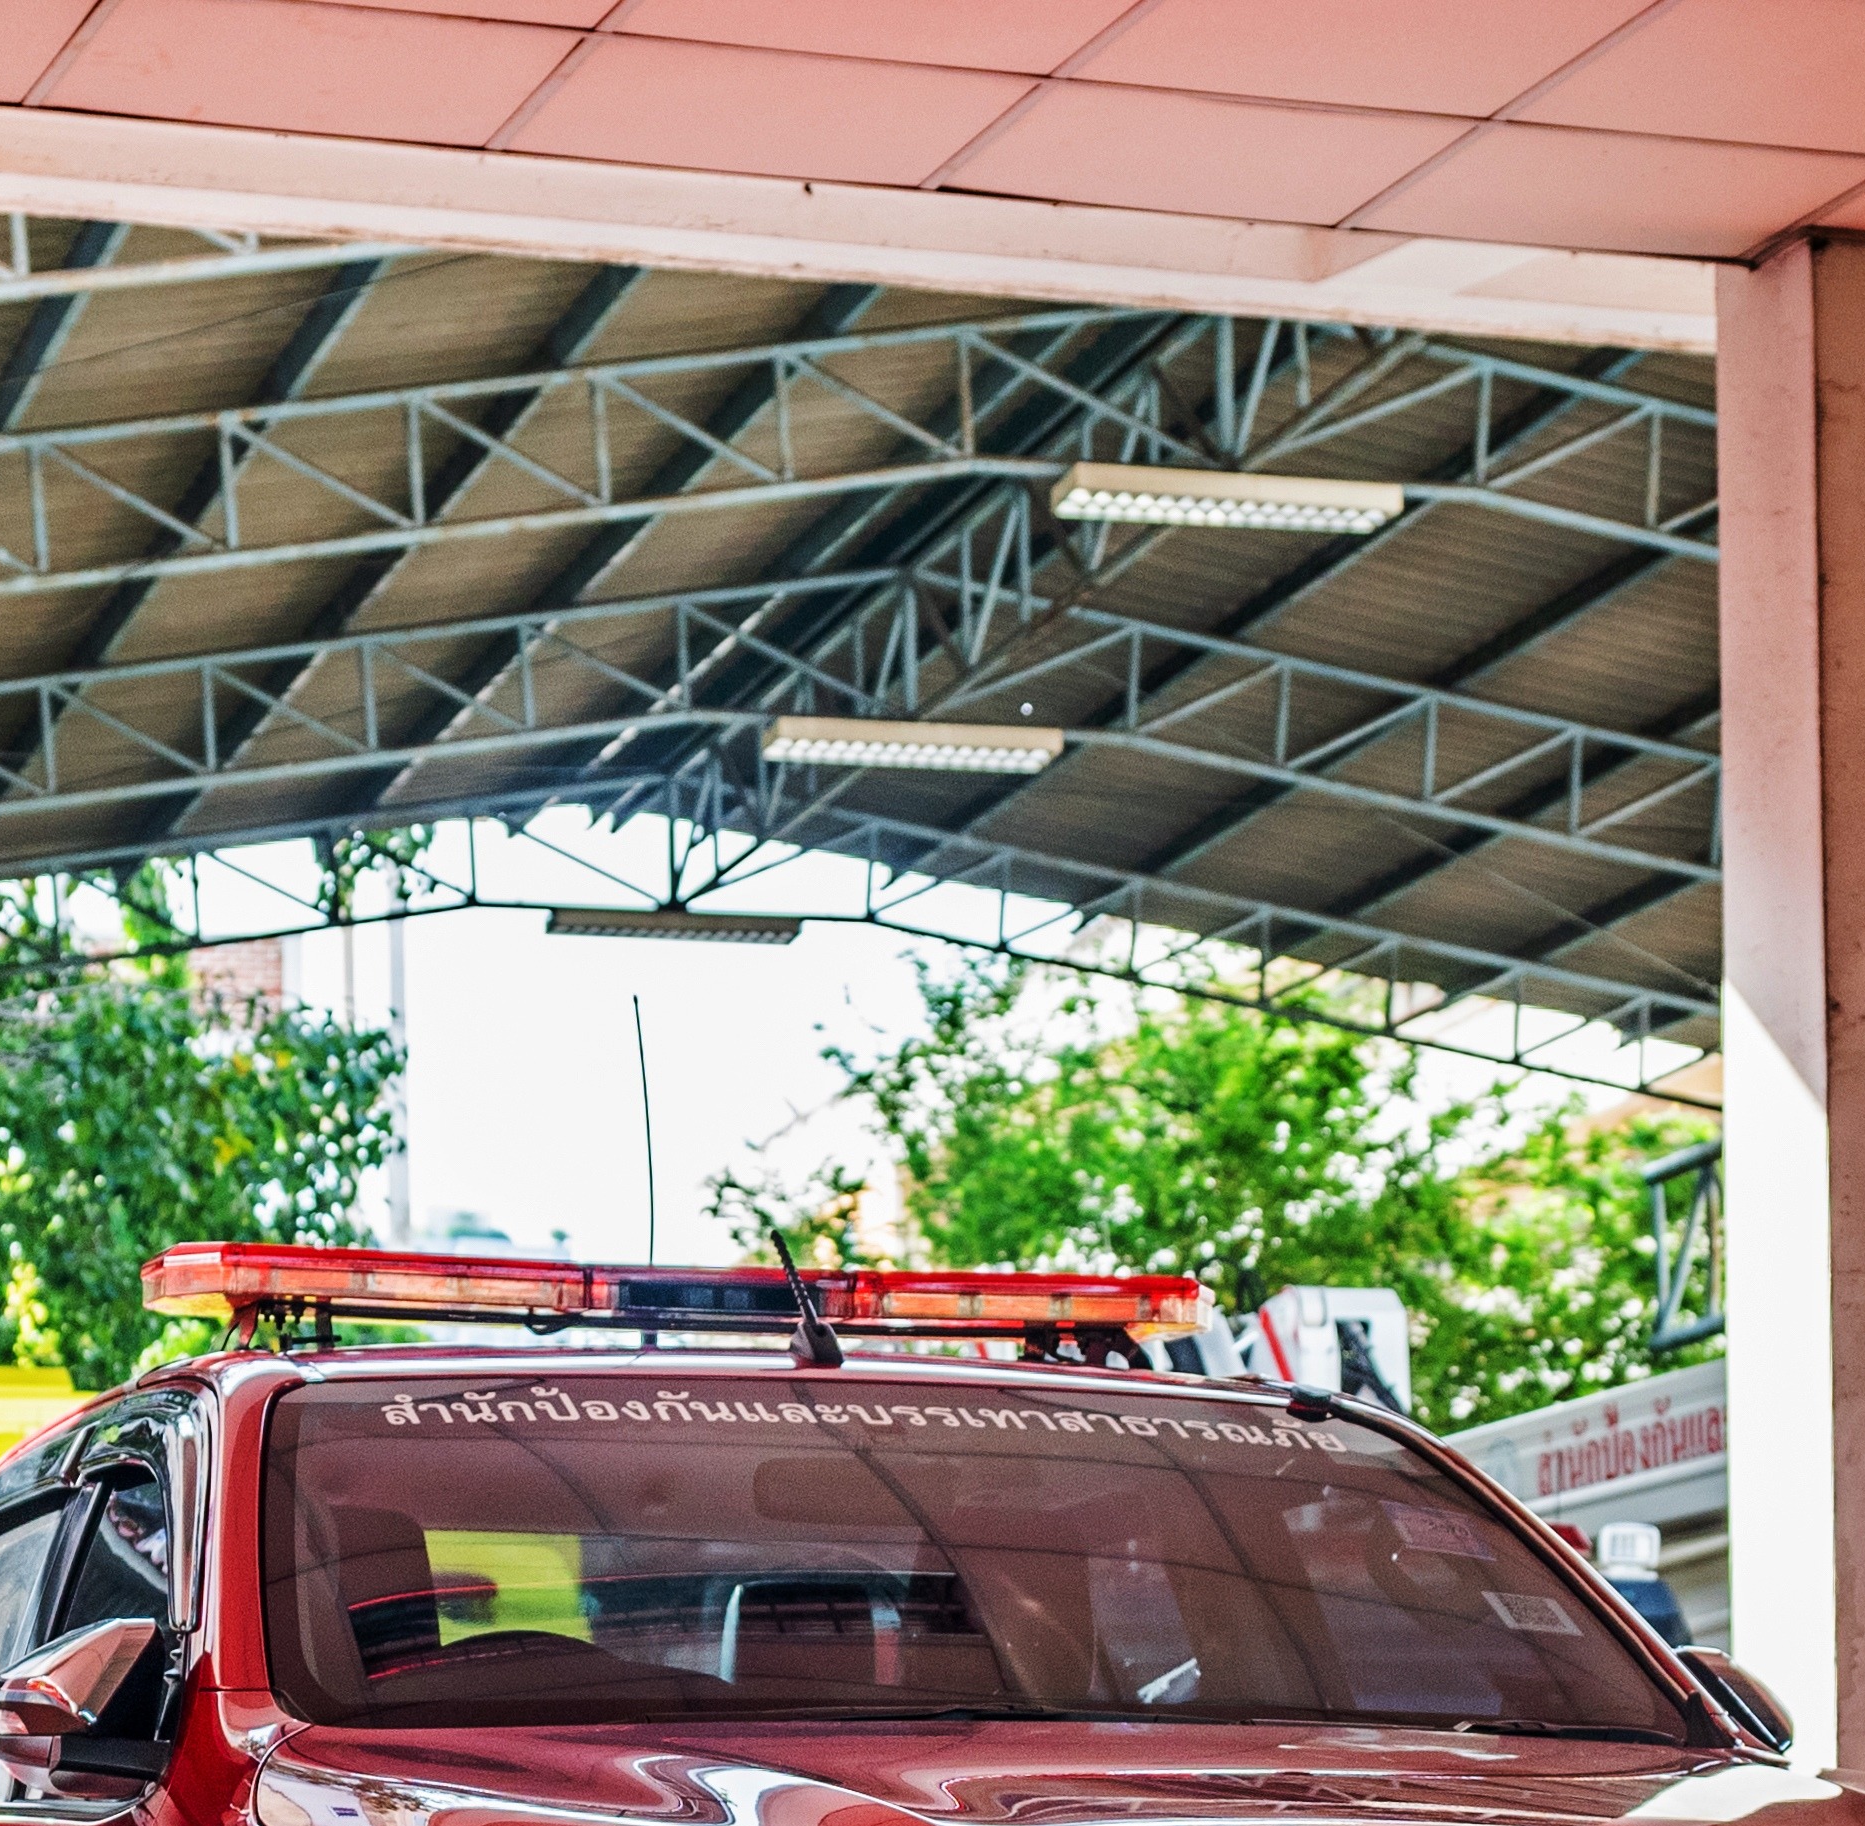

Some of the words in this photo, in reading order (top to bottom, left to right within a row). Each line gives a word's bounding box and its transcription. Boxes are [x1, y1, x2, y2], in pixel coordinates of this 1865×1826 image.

[381, 1385, 1348, 1453] สำนักป้องกันและบรรเทาสาธารณภัย
